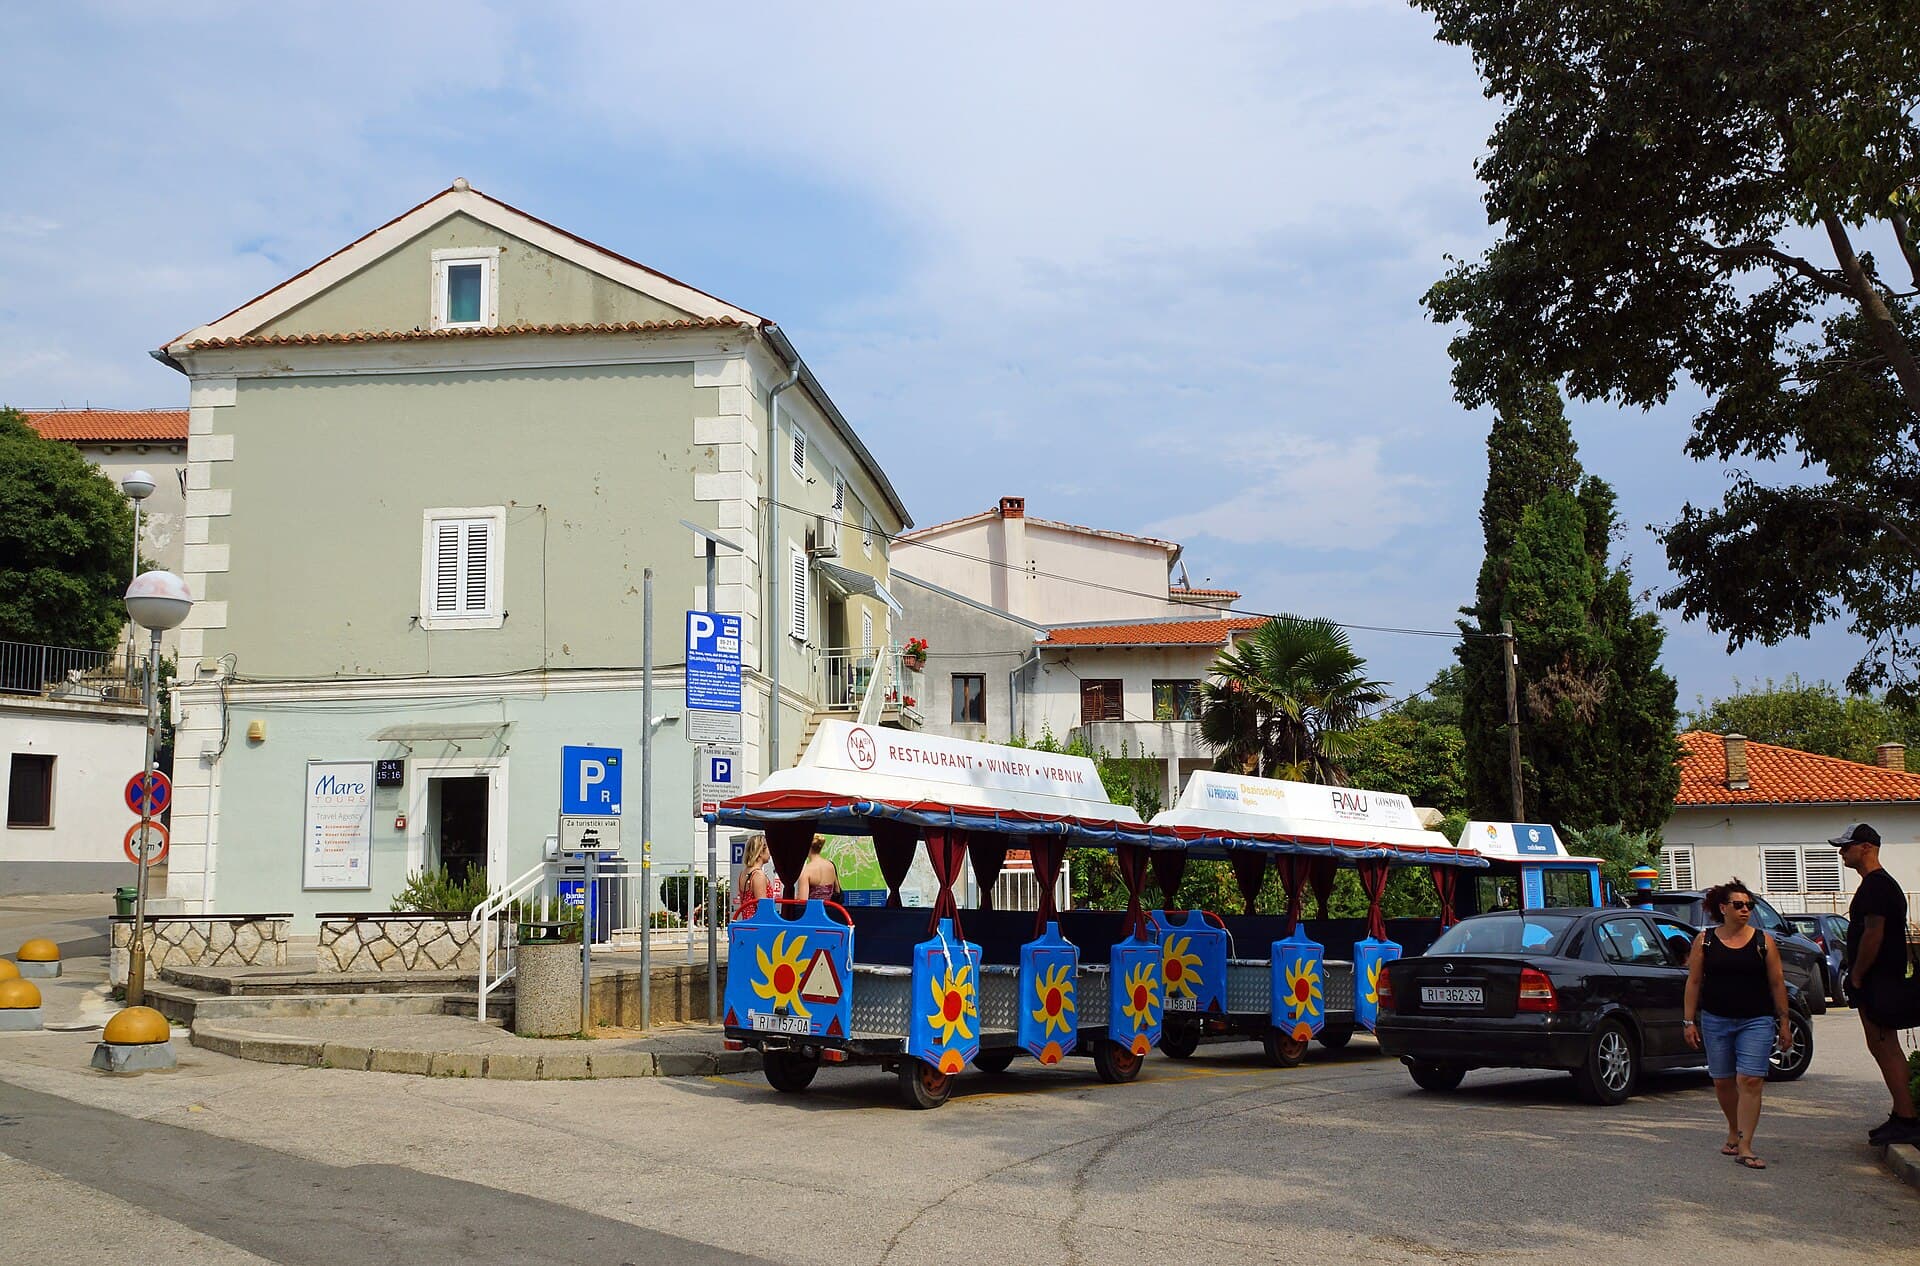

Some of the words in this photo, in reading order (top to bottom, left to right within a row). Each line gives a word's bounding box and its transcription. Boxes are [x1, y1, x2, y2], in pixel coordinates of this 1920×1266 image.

[690, 614, 715, 650] P
[381, 761, 396, 770] Sat
[716, 761, 728, 780] P
[889, 745, 973, 769] RESTAURANT
[986, 758, 1031, 777] WINERY
[1042, 766, 1084, 785] VRBNIK
[377, 771, 401, 780] 15:16
[579, 759, 606, 802] P
[315, 775, 366, 795] Mare
[601, 790, 610, 803] R
[1332, 791, 1368, 812] RAVU
[1375, 796, 1405, 809] GOSPOJA
[316, 812, 336, 821] Travel
[338, 812, 363, 823] Agency
[735, 847, 743, 862] P
[1428, 990, 1438, 1001] RI
[760, 1016, 769, 1030] RI
